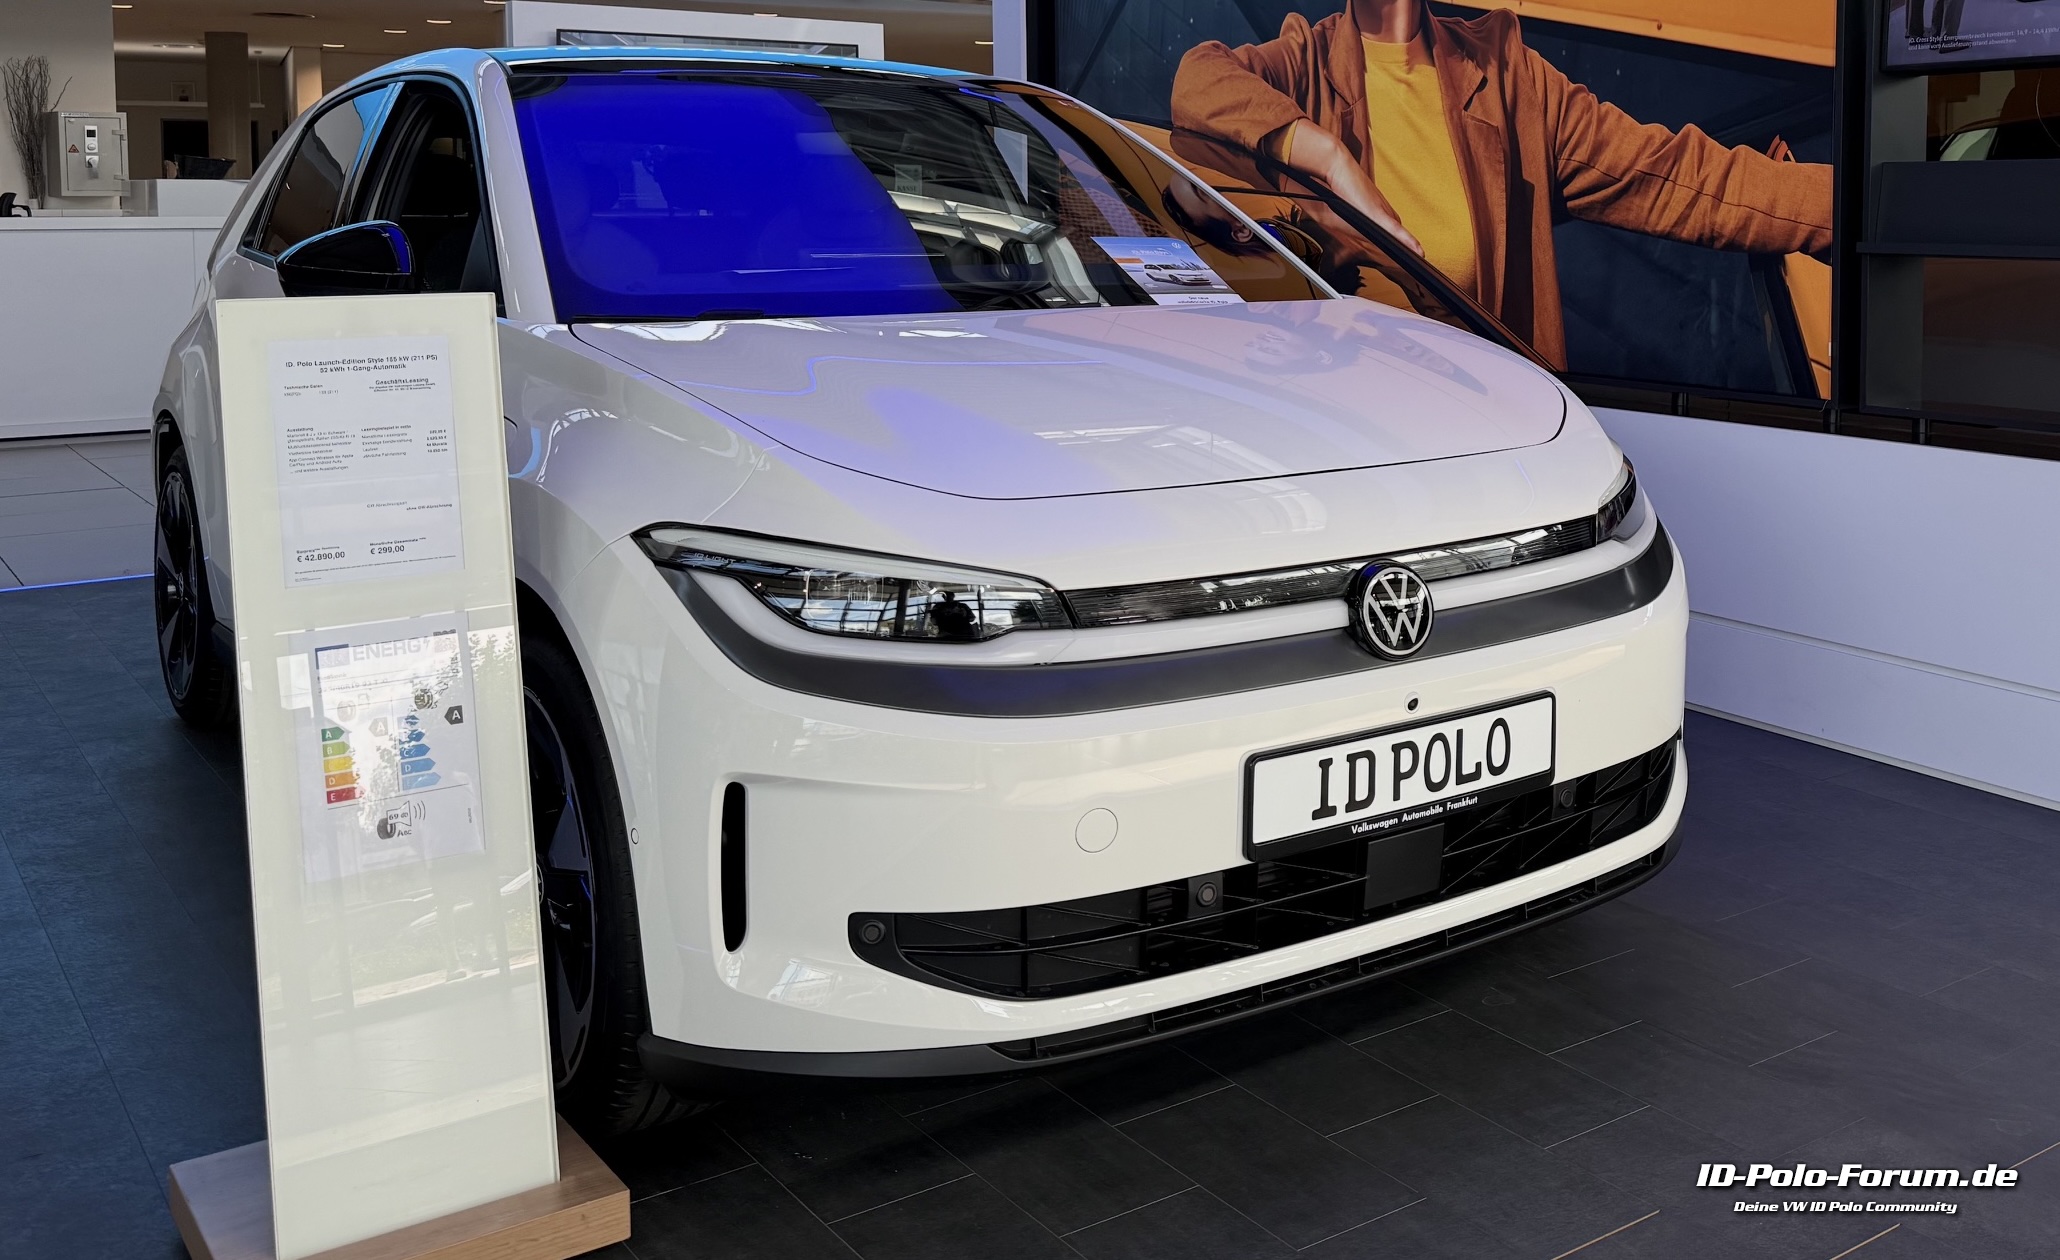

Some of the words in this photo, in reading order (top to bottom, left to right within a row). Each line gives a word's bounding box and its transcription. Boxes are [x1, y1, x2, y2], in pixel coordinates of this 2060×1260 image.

[314, 358, 366, 366] Launch-Edition
[378, 545, 405, 554] 299,00
[452, 710, 460, 720] A
[376, 721, 385, 733] A
[325, 730, 332, 738] A
[1311, 749, 1376, 821] ID
[1391, 717, 1511, 802] POLO
[329, 777, 335, 785] D
[1351, 816, 1398, 835] Volkswagen
[1402, 804, 1444, 823] Automobile
[1447, 796, 1478, 811] Frankfurt
